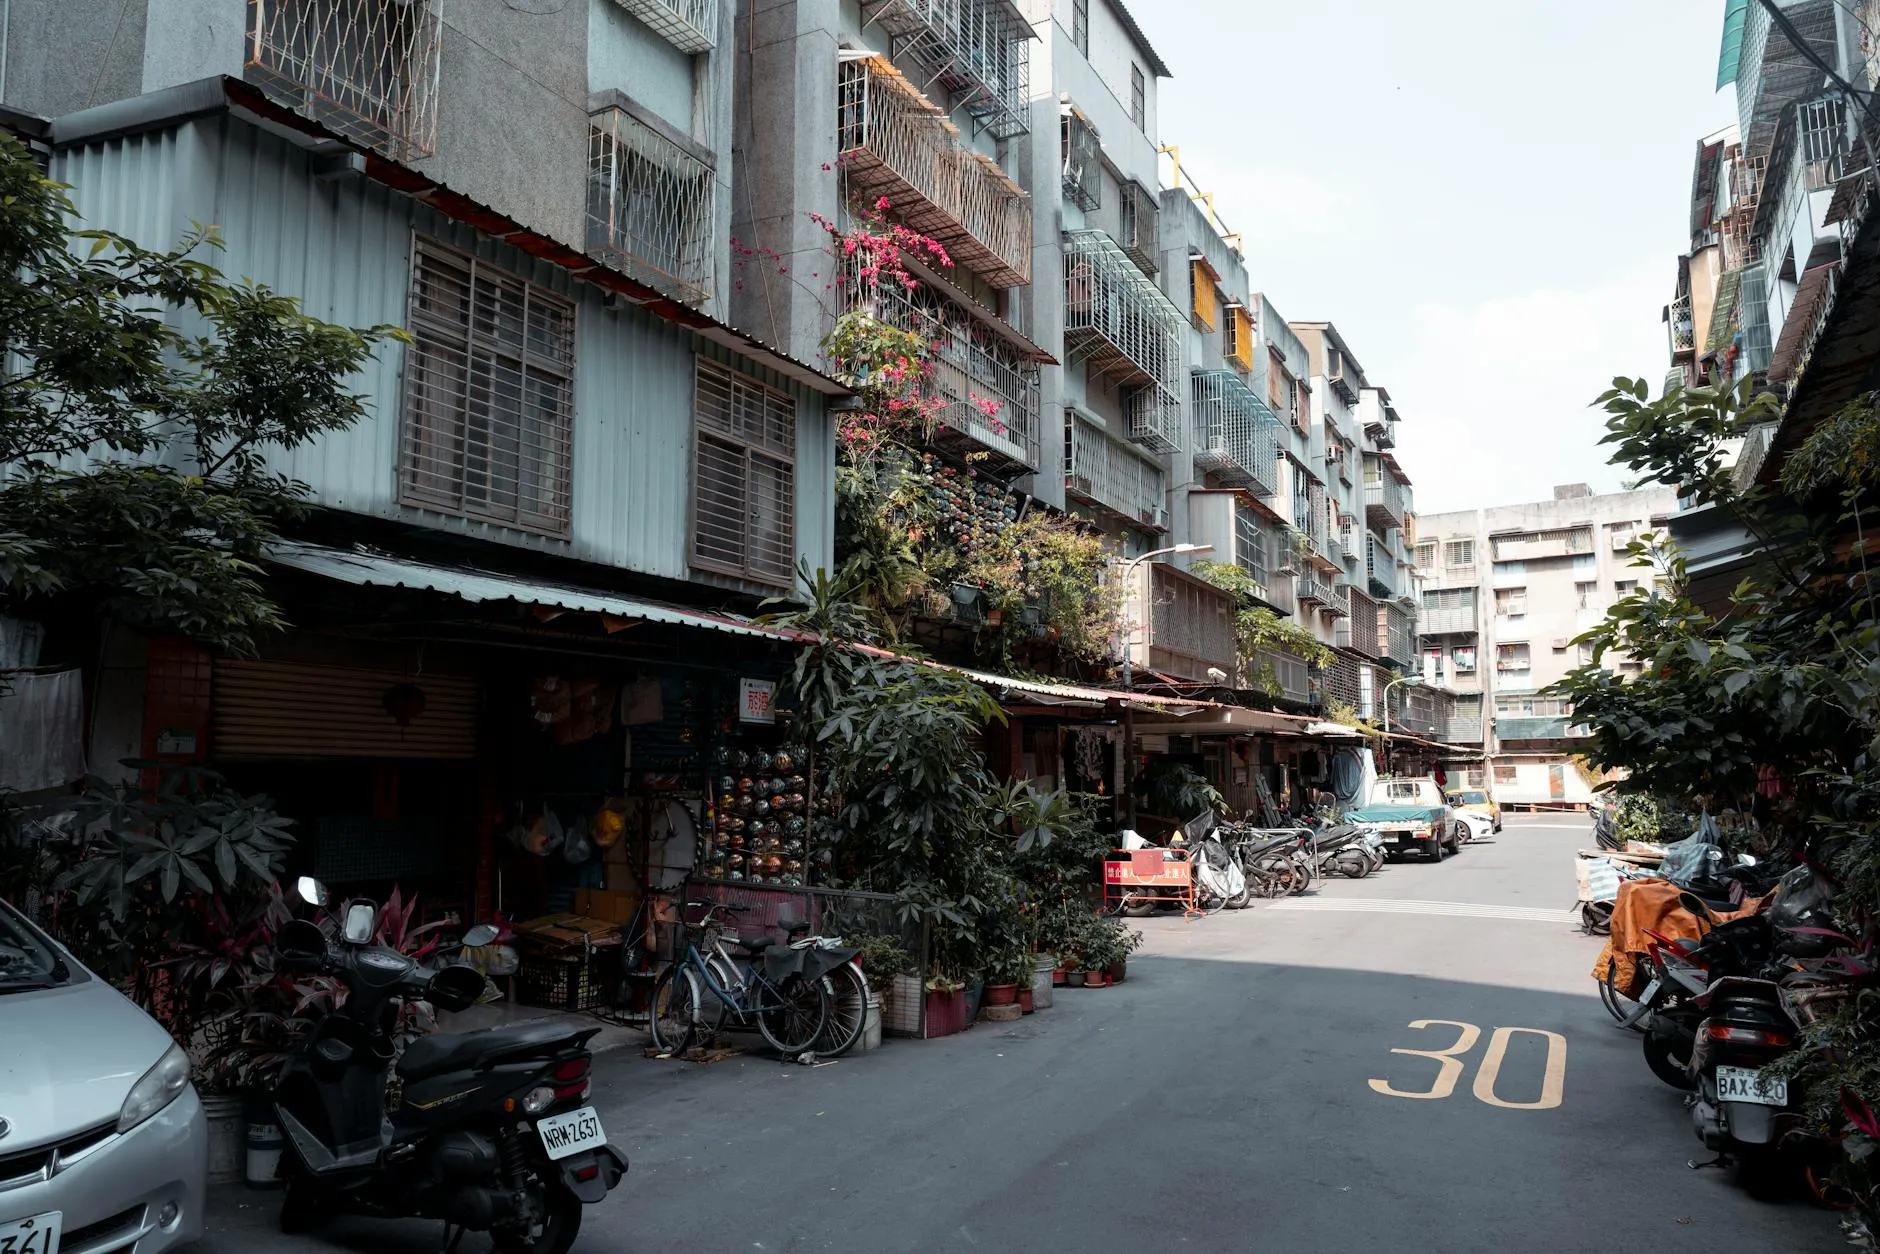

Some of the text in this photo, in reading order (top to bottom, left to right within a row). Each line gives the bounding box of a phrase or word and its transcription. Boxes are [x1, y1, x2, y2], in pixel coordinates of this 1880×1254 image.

[1107, 868, 1187, 878] 禁止進入 止進入
[1368, 1019, 1567, 1110] 30
[543, 1117, 598, 1150] NRM-2637
